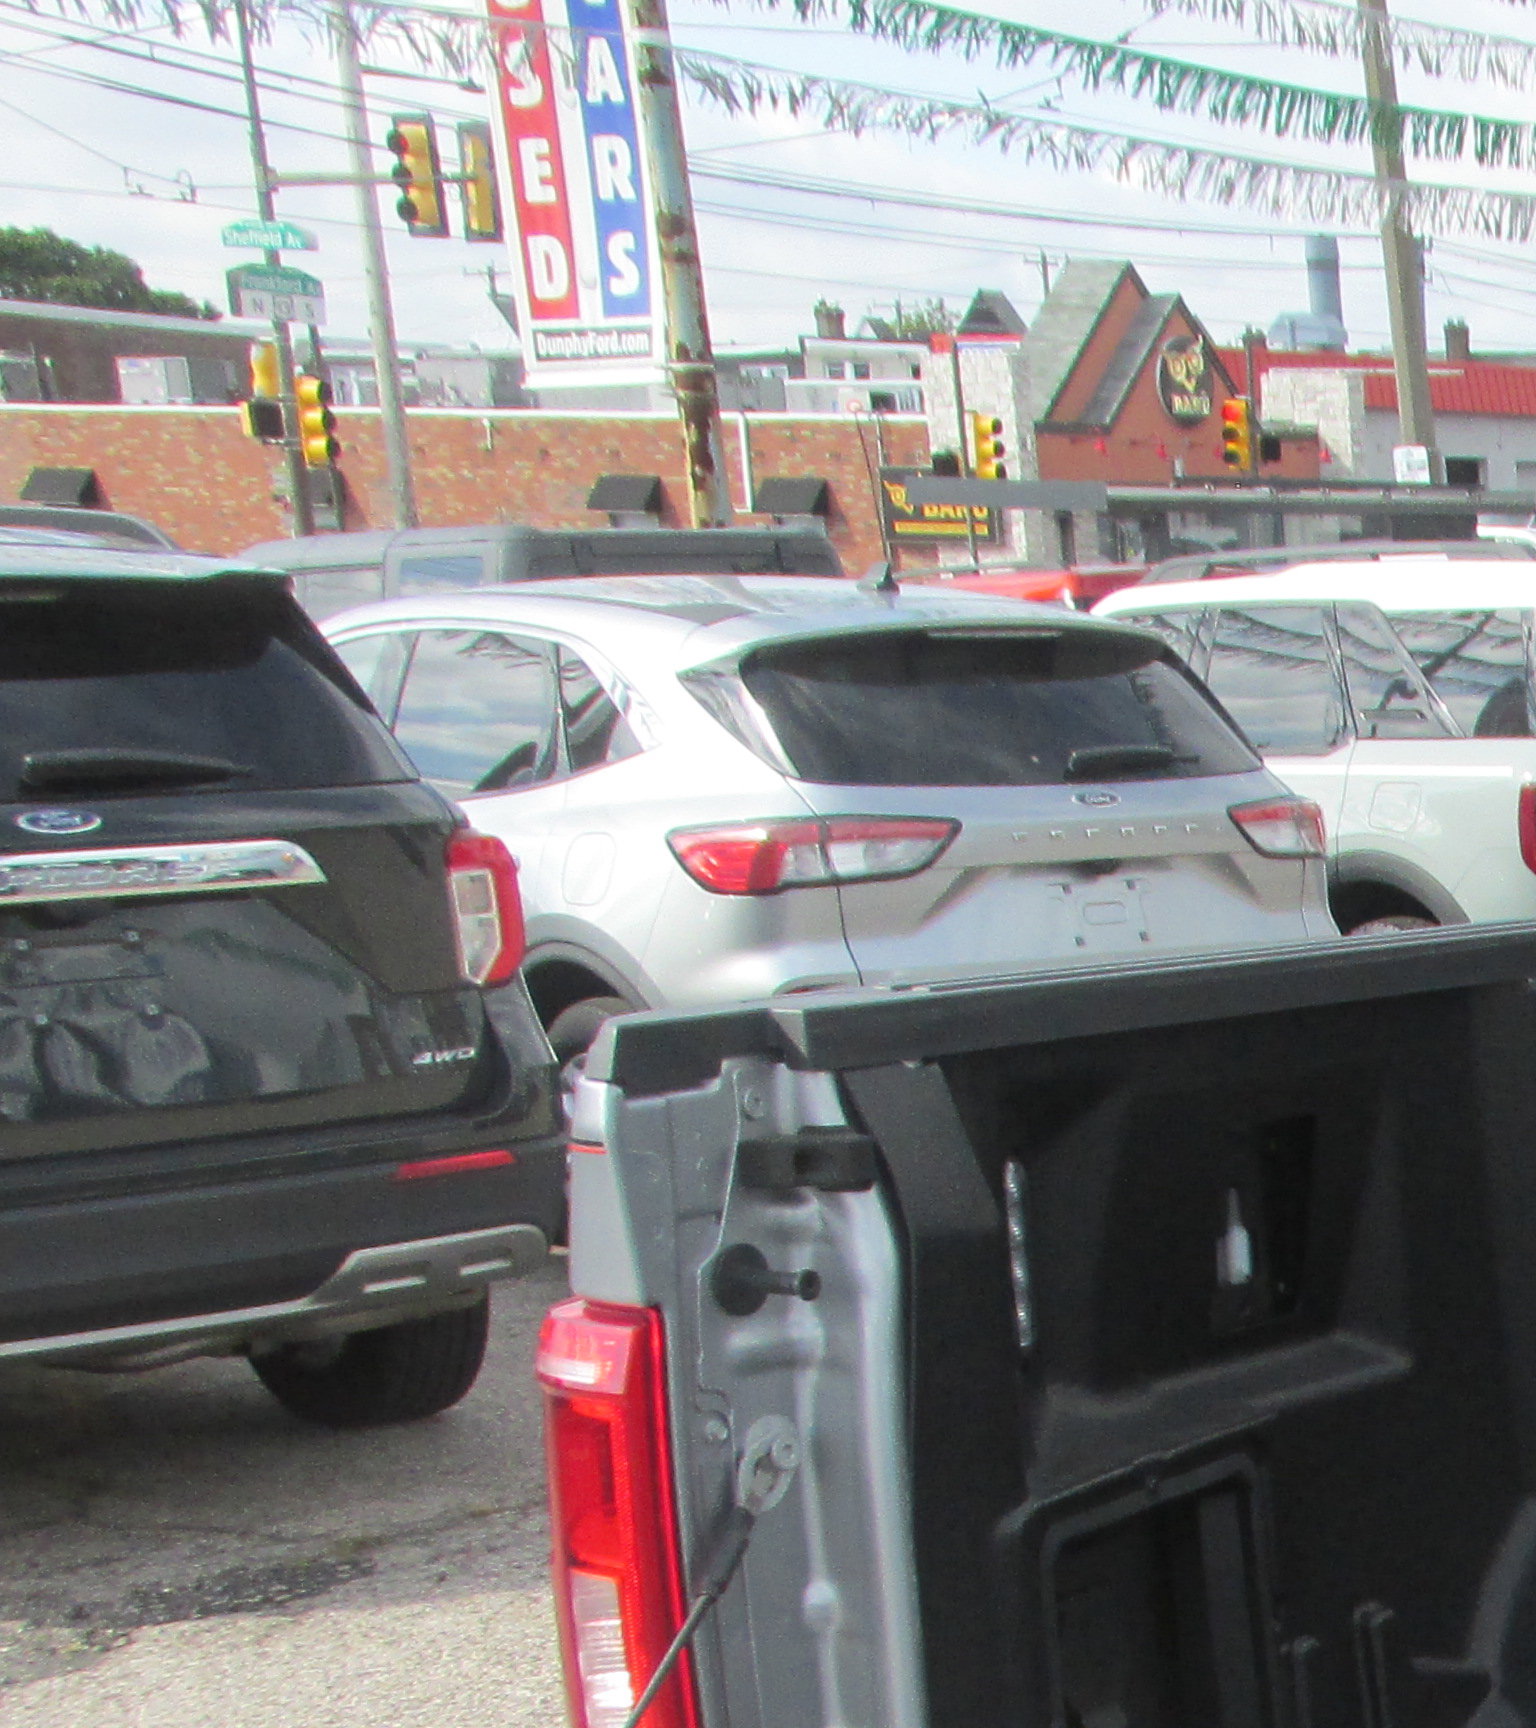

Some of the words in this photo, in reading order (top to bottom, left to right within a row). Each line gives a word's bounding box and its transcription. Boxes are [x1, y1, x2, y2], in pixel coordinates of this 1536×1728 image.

[496, 0, 570, 300] SED
[582, 0, 640, 298] ARS
[536, 330, 649, 358] DunphyFord.com
